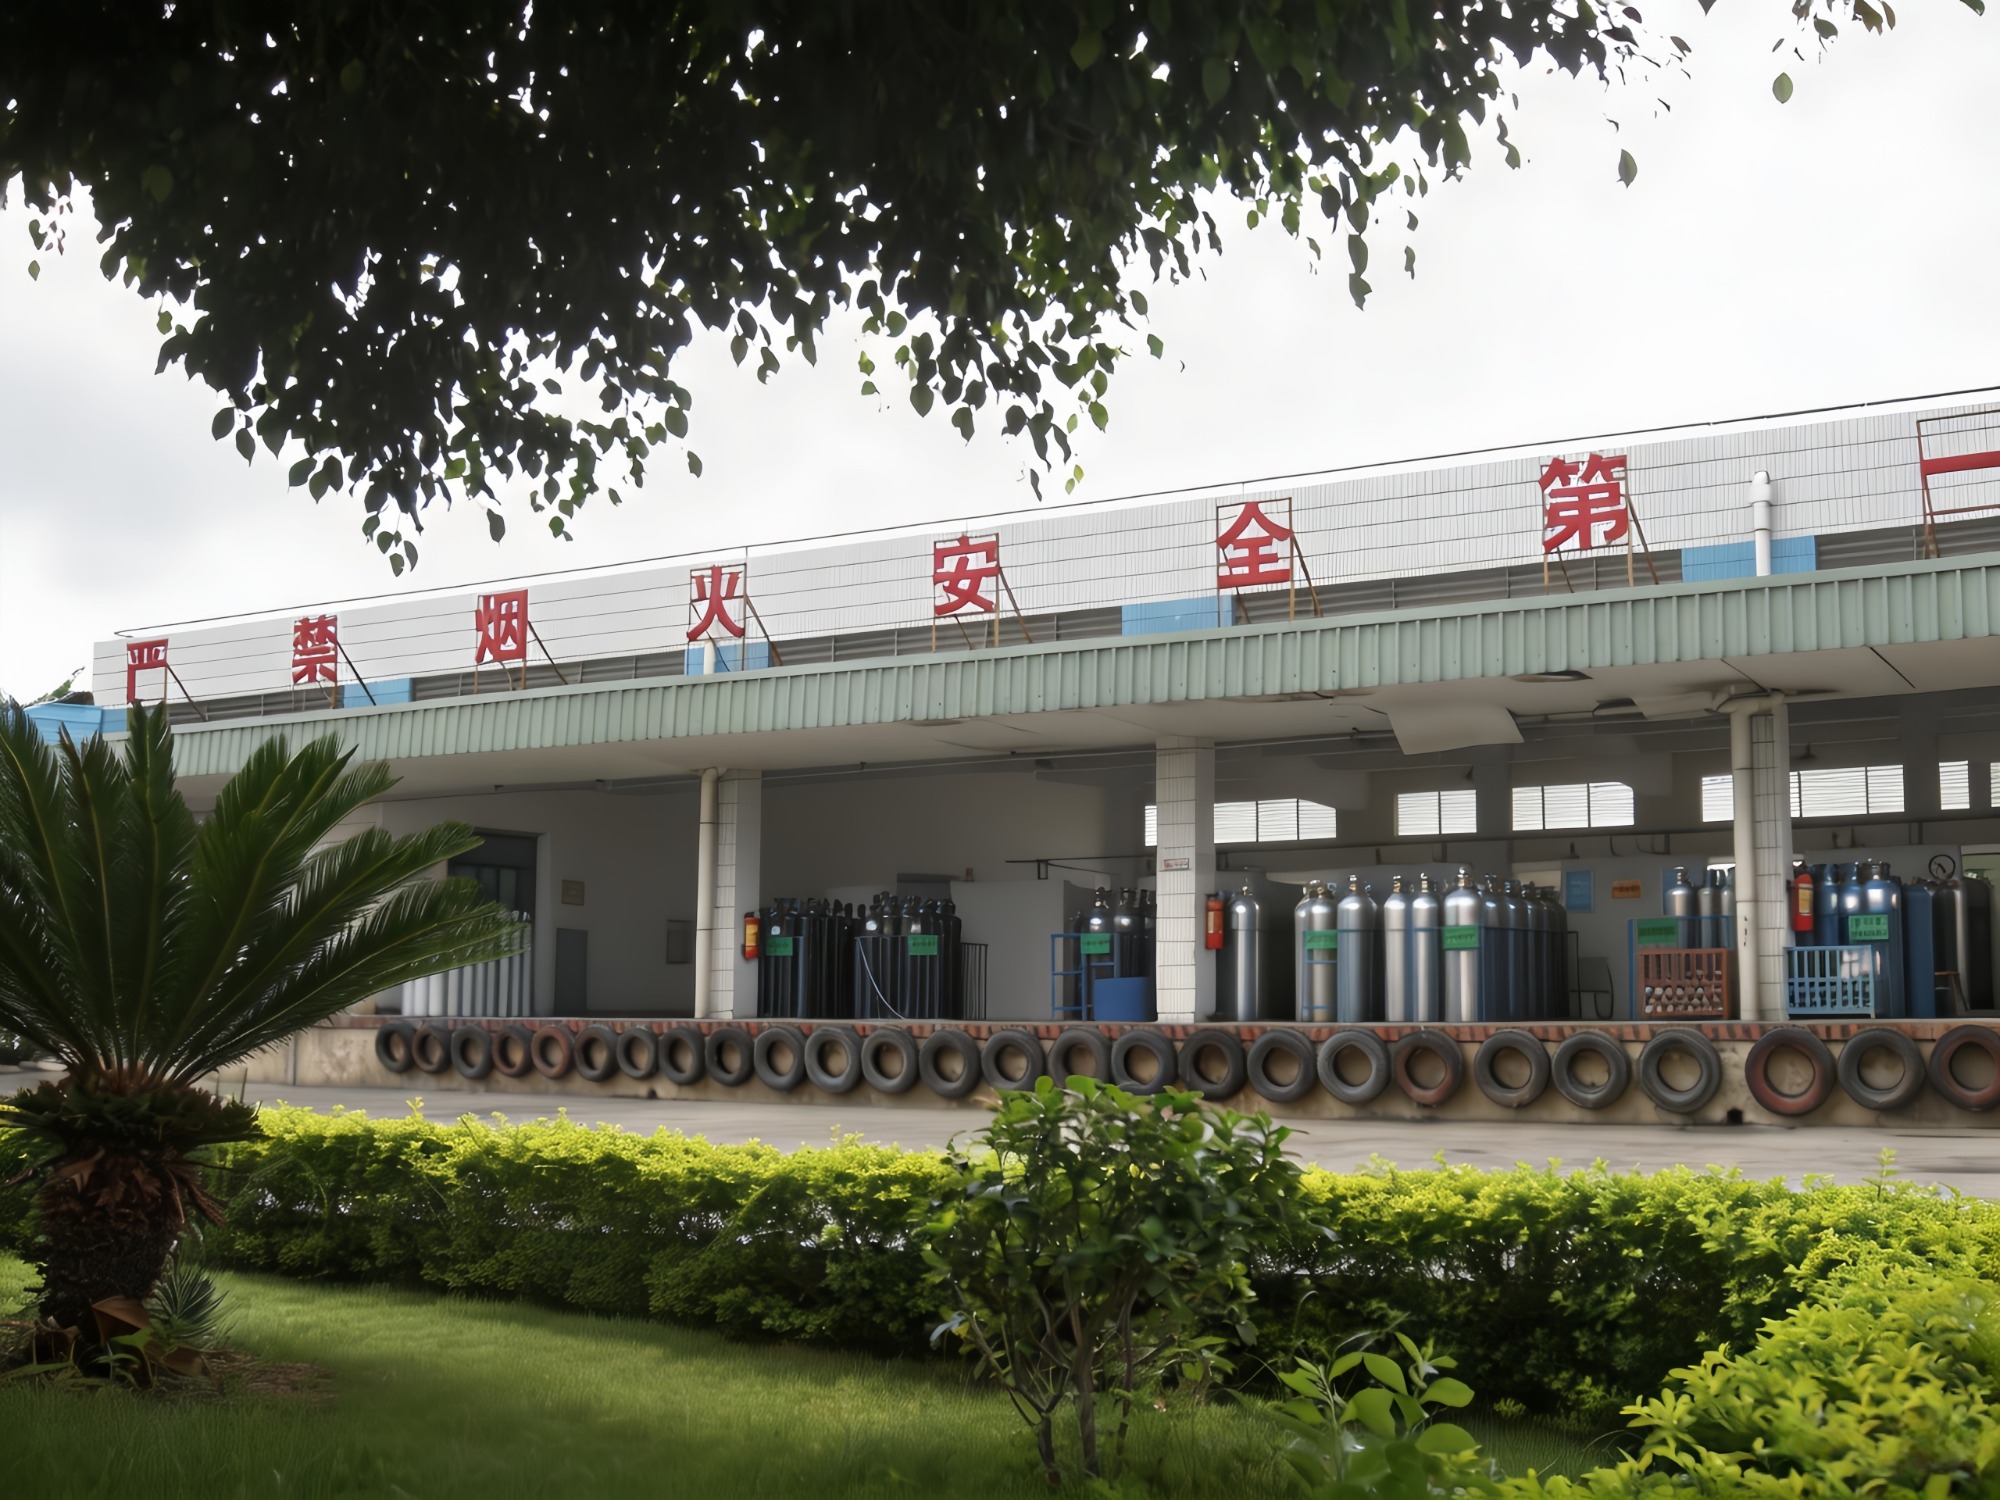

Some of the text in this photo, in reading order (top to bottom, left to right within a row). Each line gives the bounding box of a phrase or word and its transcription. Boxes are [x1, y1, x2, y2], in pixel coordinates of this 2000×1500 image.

[127, 638, 169, 704] 严
[293, 614, 338, 684] 禁
[475, 589, 529, 664] 烟
[686, 565, 745, 642] 火
[933, 535, 999, 616] 安
[1217, 501, 1293, 588] 全
[1538, 453, 1629, 554] 第
